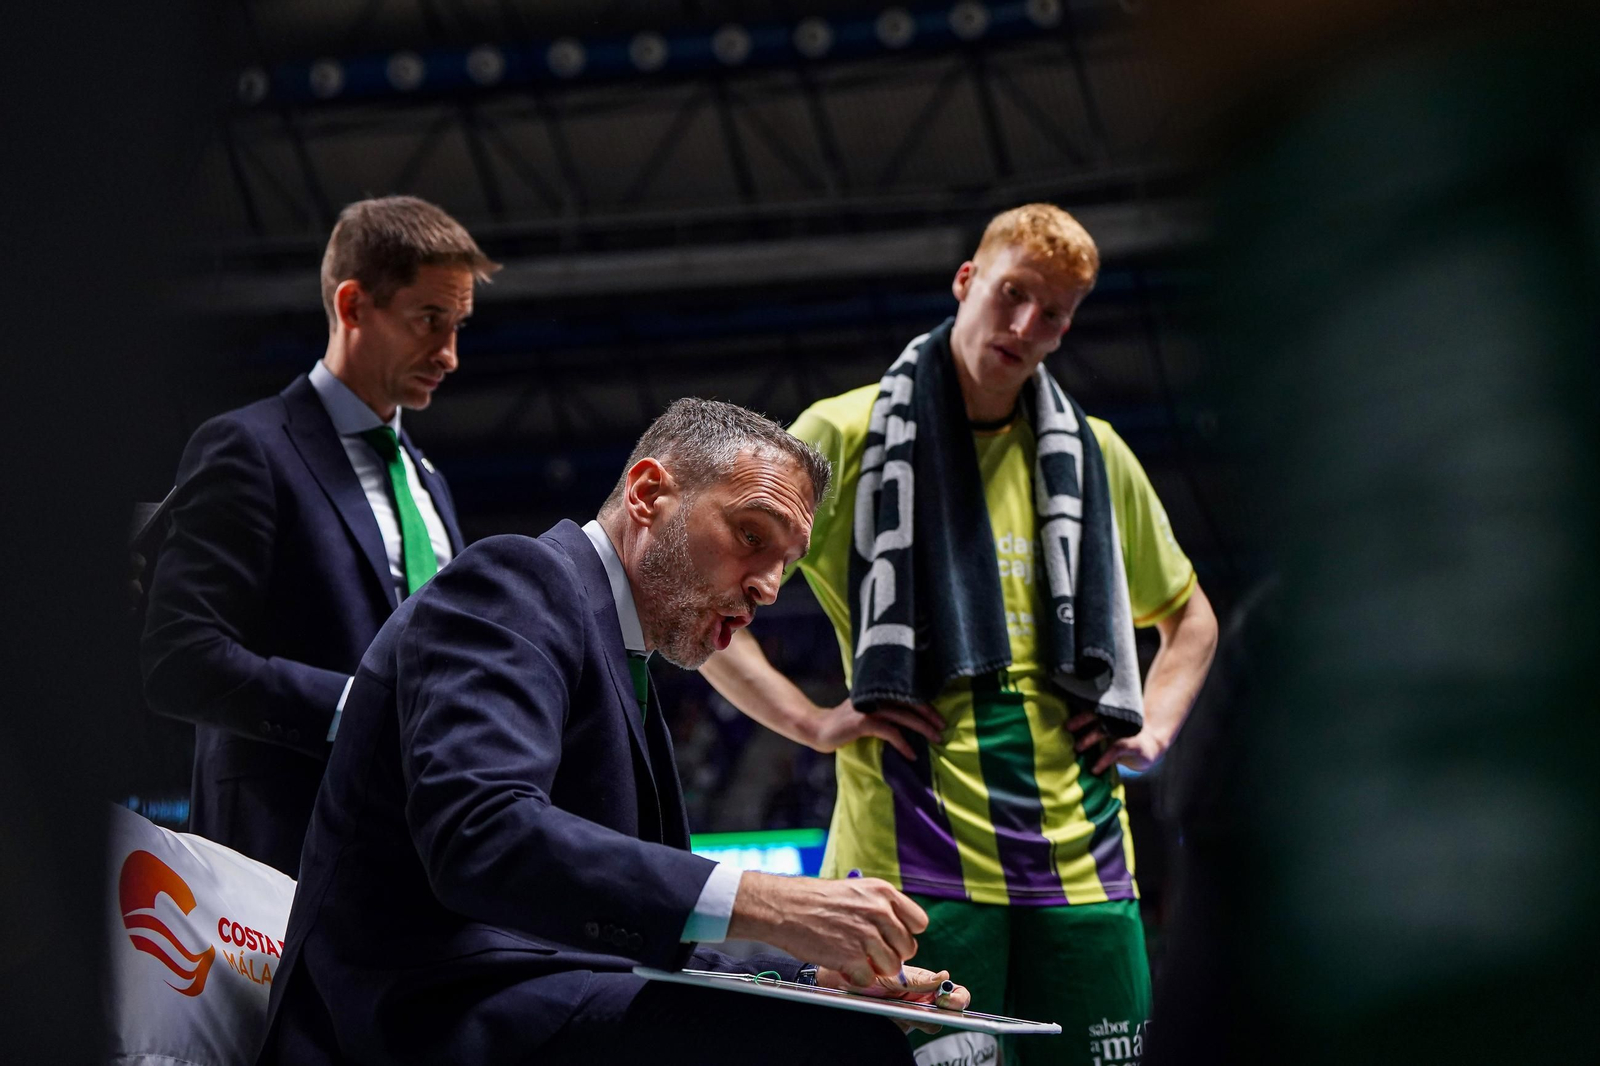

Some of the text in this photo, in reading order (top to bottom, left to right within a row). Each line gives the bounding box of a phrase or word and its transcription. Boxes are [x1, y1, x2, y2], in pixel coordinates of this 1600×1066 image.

[217, 917, 280, 958] COSTA
[222, 950, 273, 985] MÁLA
[1088, 1017, 1130, 1037] sabor
